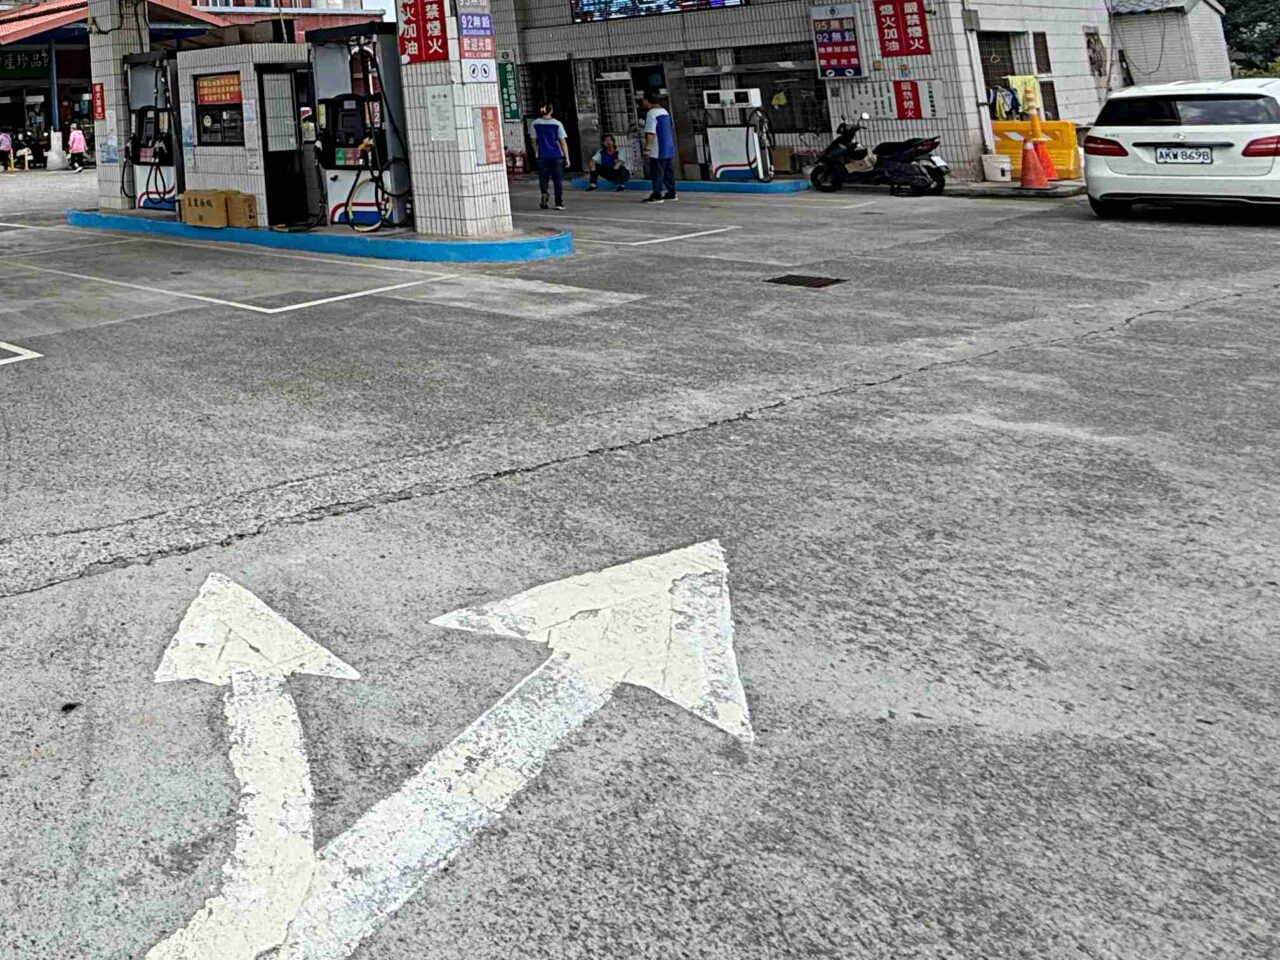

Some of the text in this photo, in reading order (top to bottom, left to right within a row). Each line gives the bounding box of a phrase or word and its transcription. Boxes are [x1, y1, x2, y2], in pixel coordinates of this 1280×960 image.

[879, 4, 900, 51] 熄火加油
[903, 2, 925, 50] 嚴禁煙火
